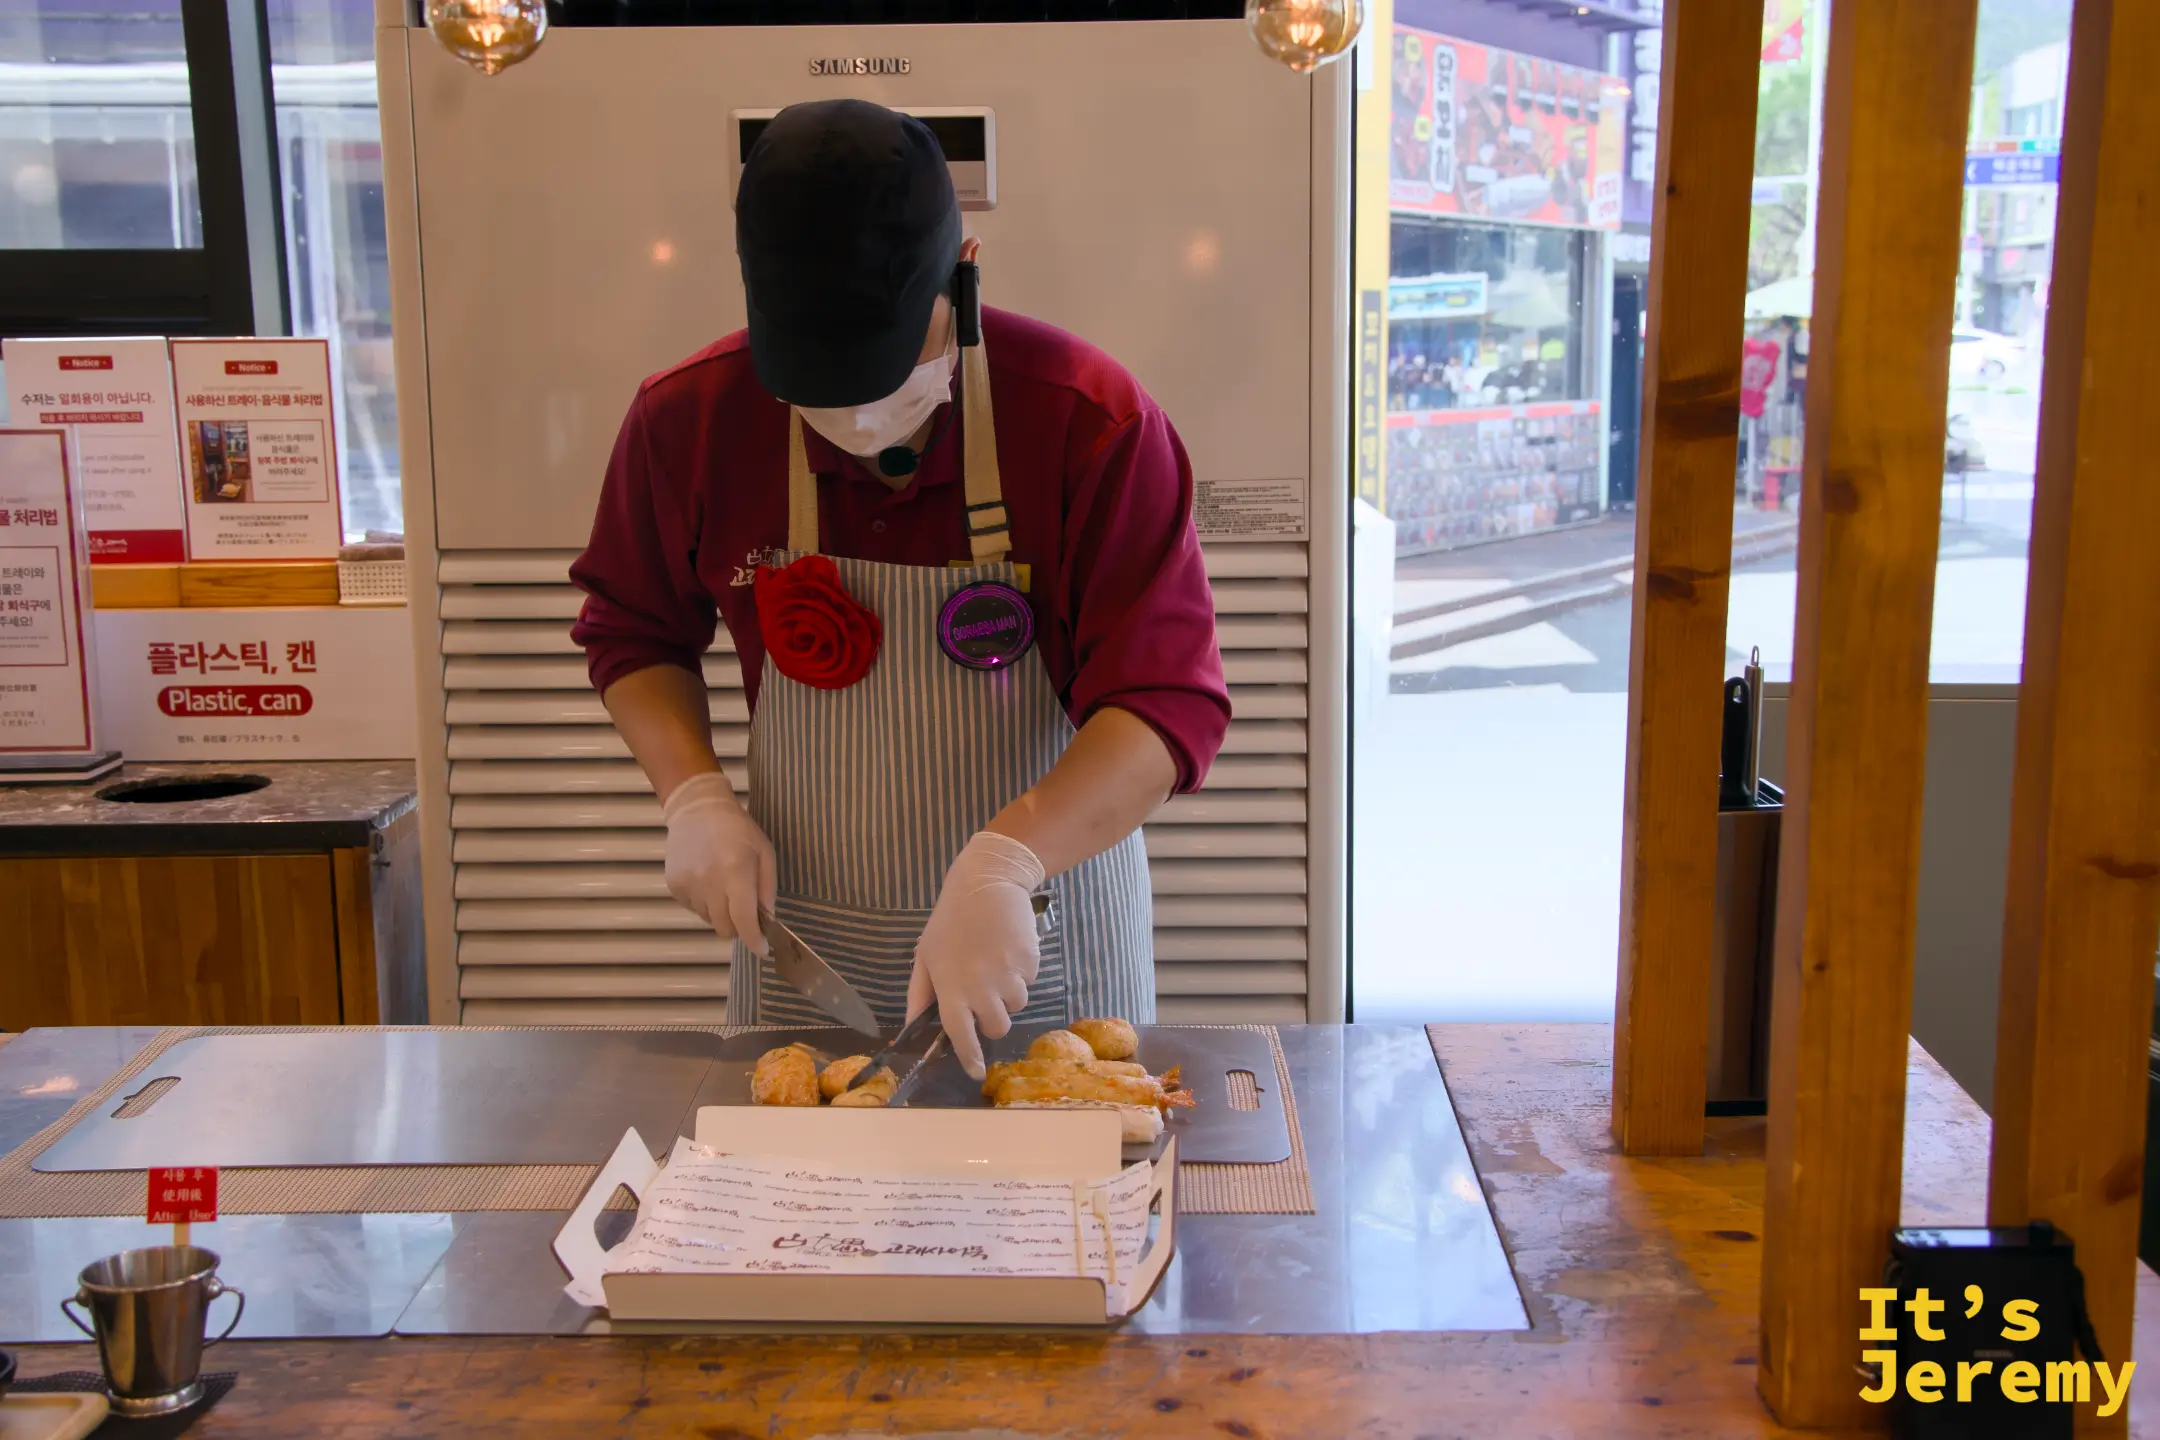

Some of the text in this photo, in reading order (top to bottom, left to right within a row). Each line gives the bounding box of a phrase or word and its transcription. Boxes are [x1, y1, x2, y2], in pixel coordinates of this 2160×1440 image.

[810, 57, 911, 75] SAMSUNG
[72, 358, 100, 368] Notice
[238, 363, 266, 372] Notice
[21, 391, 156, 406] 수저는 일회용이 아닙니다.
[185, 394, 225, 406] 사용하신
[293, 394, 323, 406] 처리법
[14, 508, 58, 527] 처리법
[2, 567, 45, 579] 트레이와
[0, 583, 23, 596] 물은
[8, 599, 51, 612] 퇴식구에
[147, 640, 317, 675] 플라스틱, 캔
[168, 688, 302, 715] Plastic, can
[162, 1188, 203, 1203] 使用後
[152, 1211, 183, 1222] After
